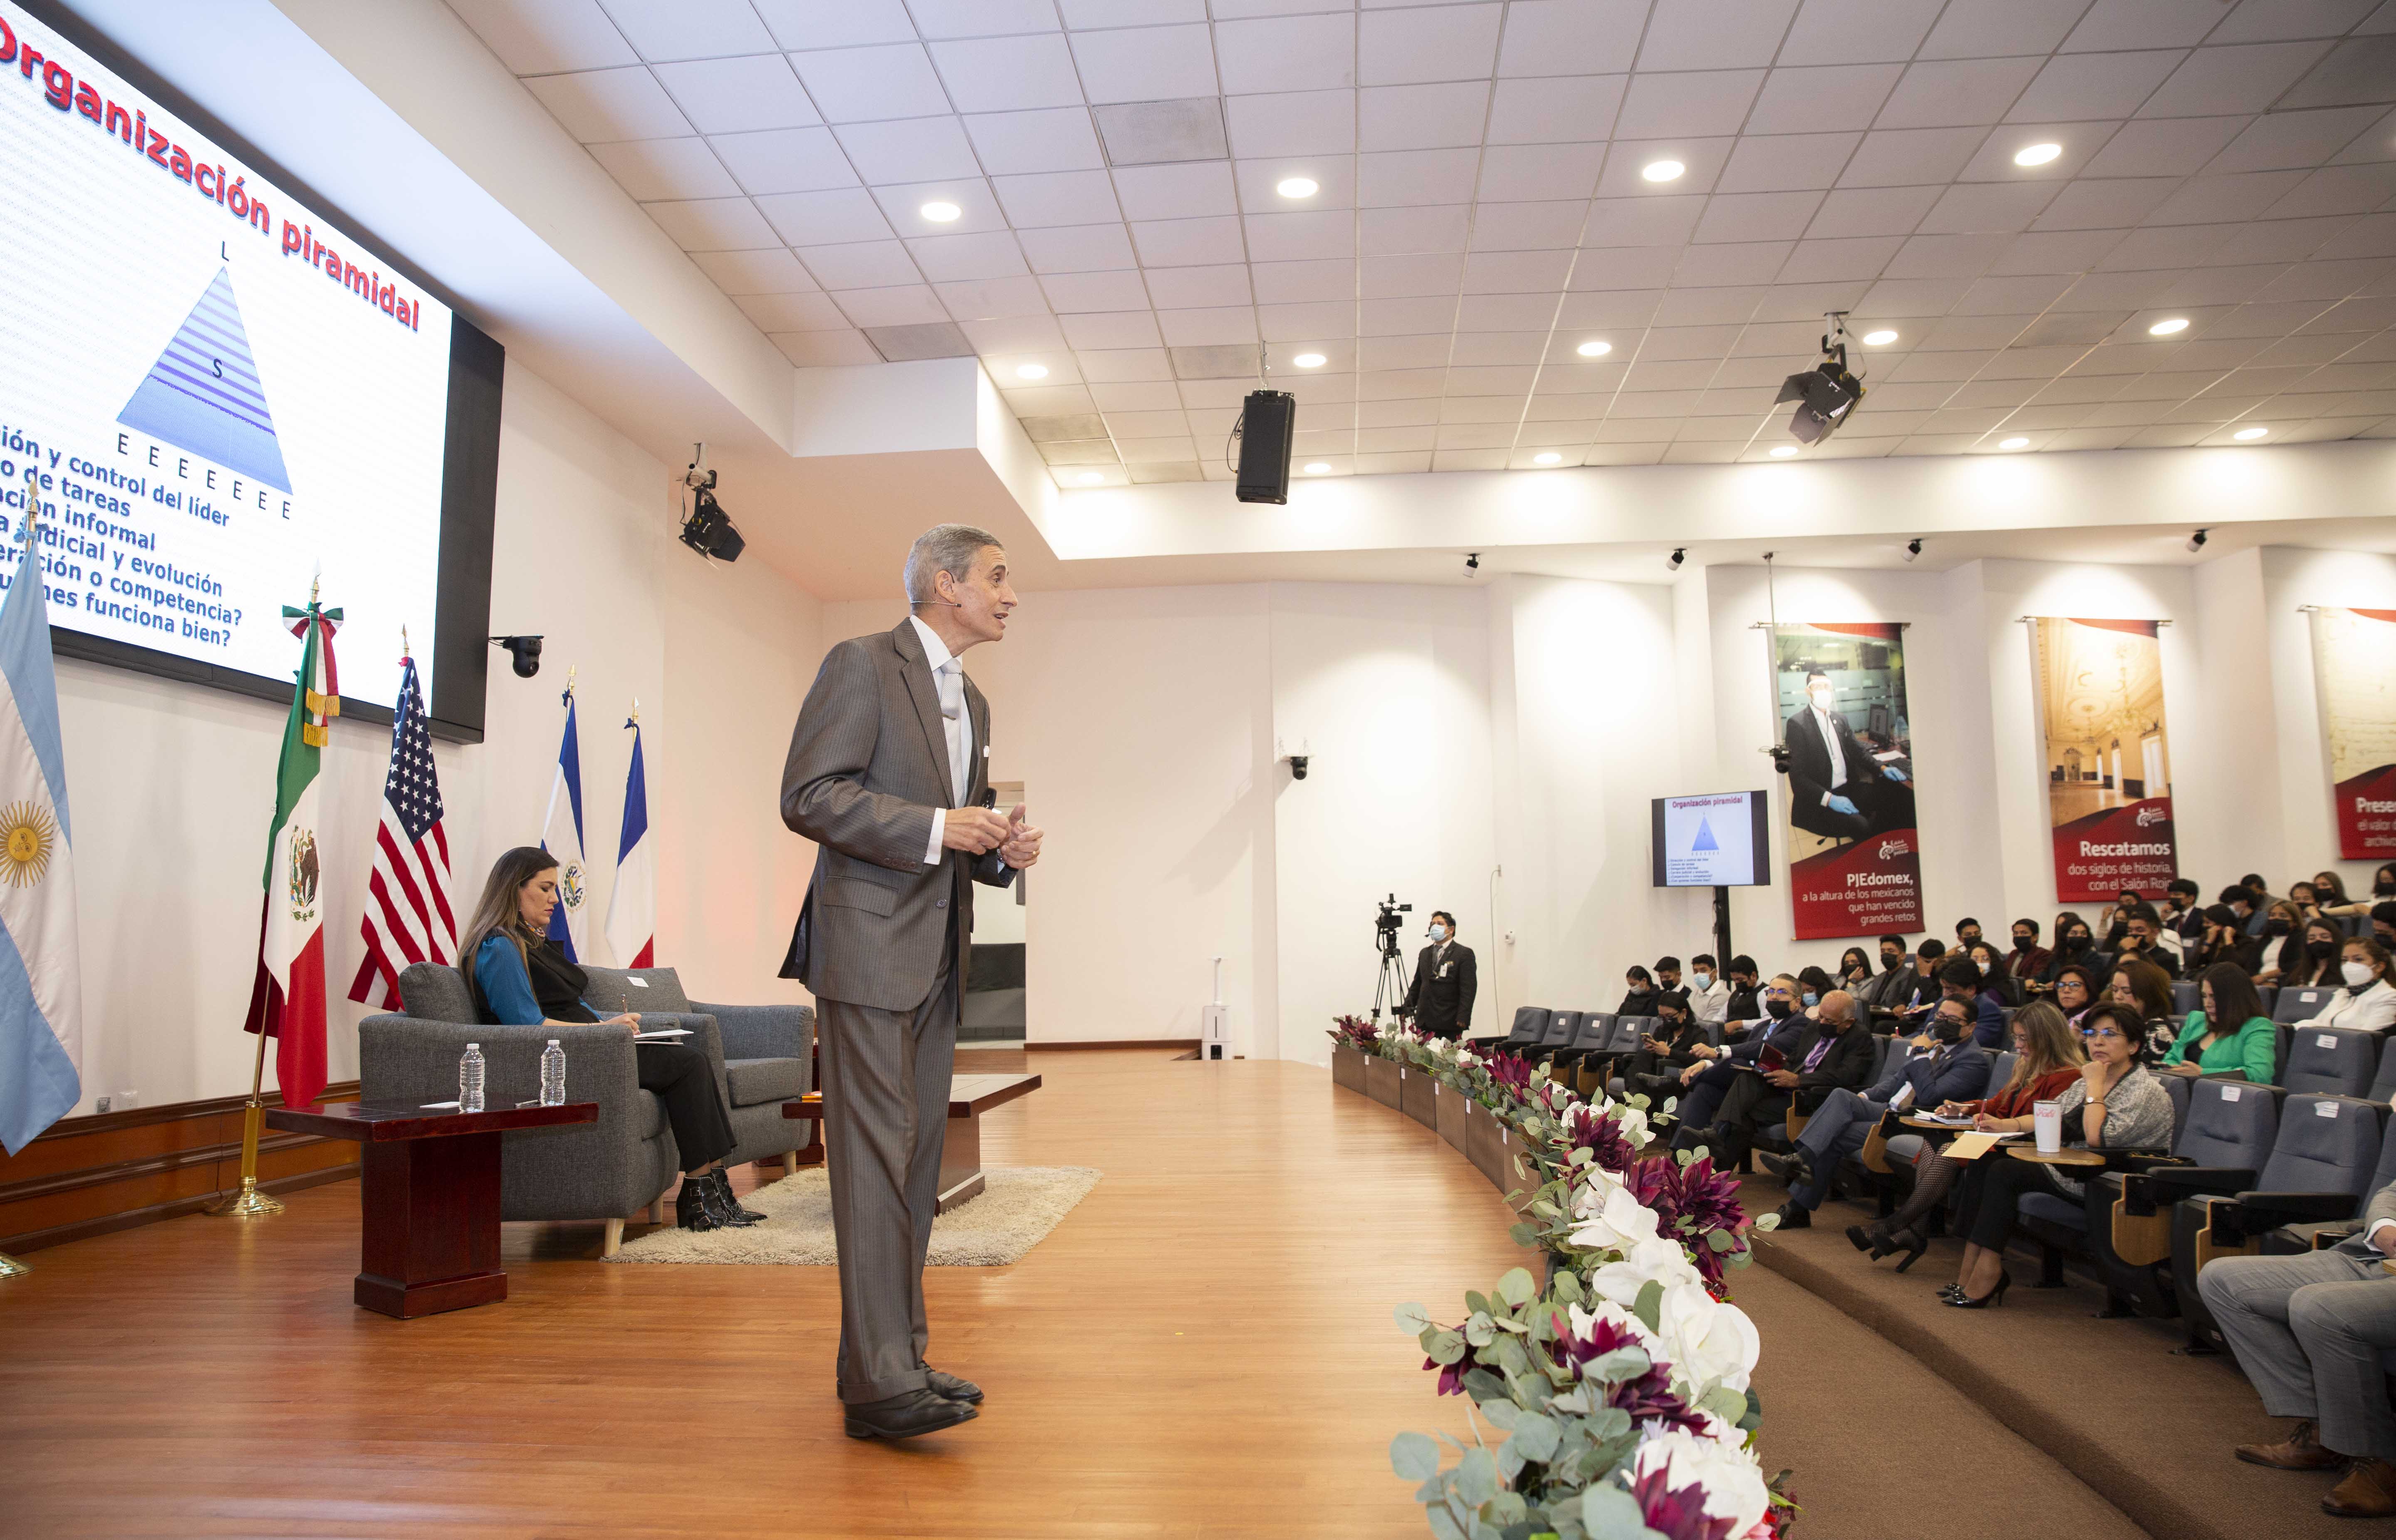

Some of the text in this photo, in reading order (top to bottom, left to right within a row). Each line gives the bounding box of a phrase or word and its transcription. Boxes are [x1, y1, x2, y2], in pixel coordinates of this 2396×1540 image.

[222, 240, 229, 262] L
[282, 219, 419, 333] piramidal
[212, 358, 222, 378] S
[118, 433, 291, 520] E E E E E E E
[24, 465, 53, 491] de
[61, 476, 131, 517] tareas
[48, 448, 62, 468] y
[69, 457, 146, 496] control
[153, 485, 182, 510] del
[188, 495, 230, 527] líder
[65, 504, 155, 551] informal
[20, 517, 105, 561] dicial
[113, 550, 124, 570] y
[131, 557, 222, 597] evolución
[89, 571, 103, 587] o
[110, 577, 242, 626] competencia?
[86, 592, 174, 633] funciona
[182, 617, 230, 646] bien?
[1672, 796, 1743, 810] Organización piramidal
[2080, 840, 2171, 857] Rescatamos
[1847, 872, 1913, 888] PJEdomex,
[2067, 861, 2172, 878] dos siglos de historia,
[2088, 881, 2108, 891] con
[2109, 878, 2119, 891] el
[2120, 877, 2148, 891] Salón
[1802, 888, 1914, 902] a la altura de los mexicanos
[1848, 899, 1916, 914] que han vencido
[1860, 912, 1916, 927] grandes retos
